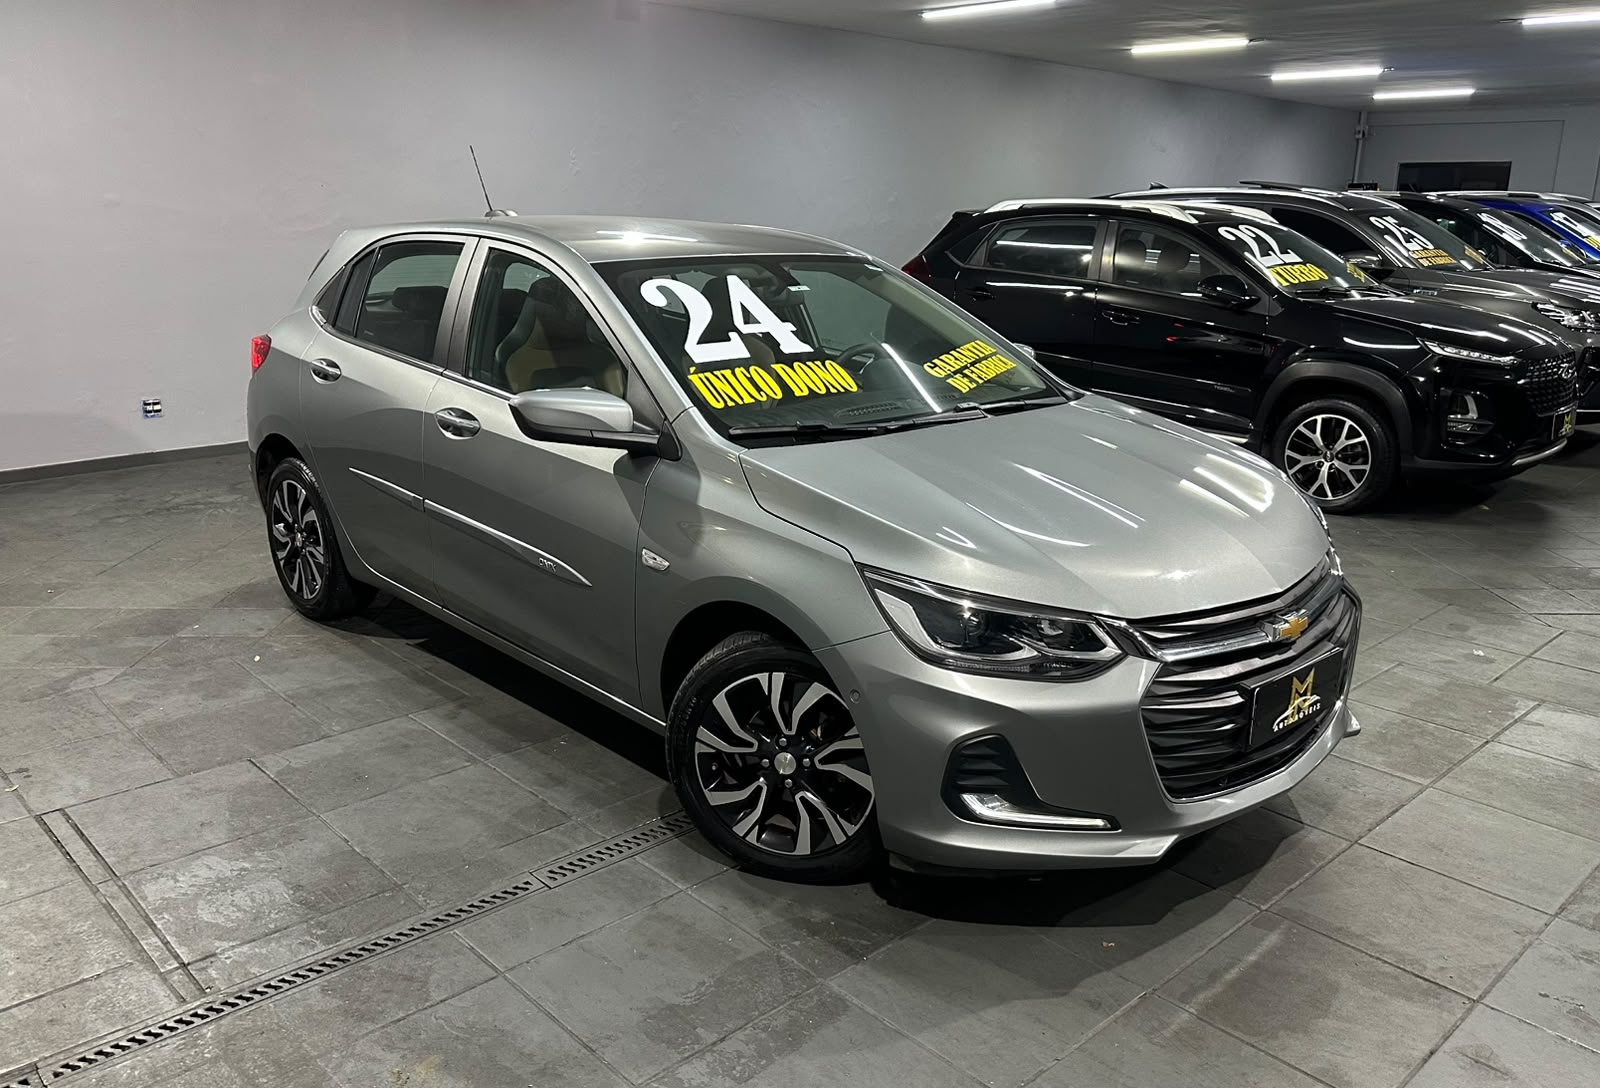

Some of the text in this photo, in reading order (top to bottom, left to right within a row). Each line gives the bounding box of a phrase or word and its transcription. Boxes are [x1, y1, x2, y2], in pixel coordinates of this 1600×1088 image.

[1217, 224, 1304, 268] 22
[1368, 215, 1435, 251] 25
[1268, 263, 1329, 287] TURBO
[640, 274, 815, 364] 24
[923, 339, 997, 378] GARANTIA
[688, 360, 858, 410] ÚNICO DONO
[946, 373, 978, 394] DE
